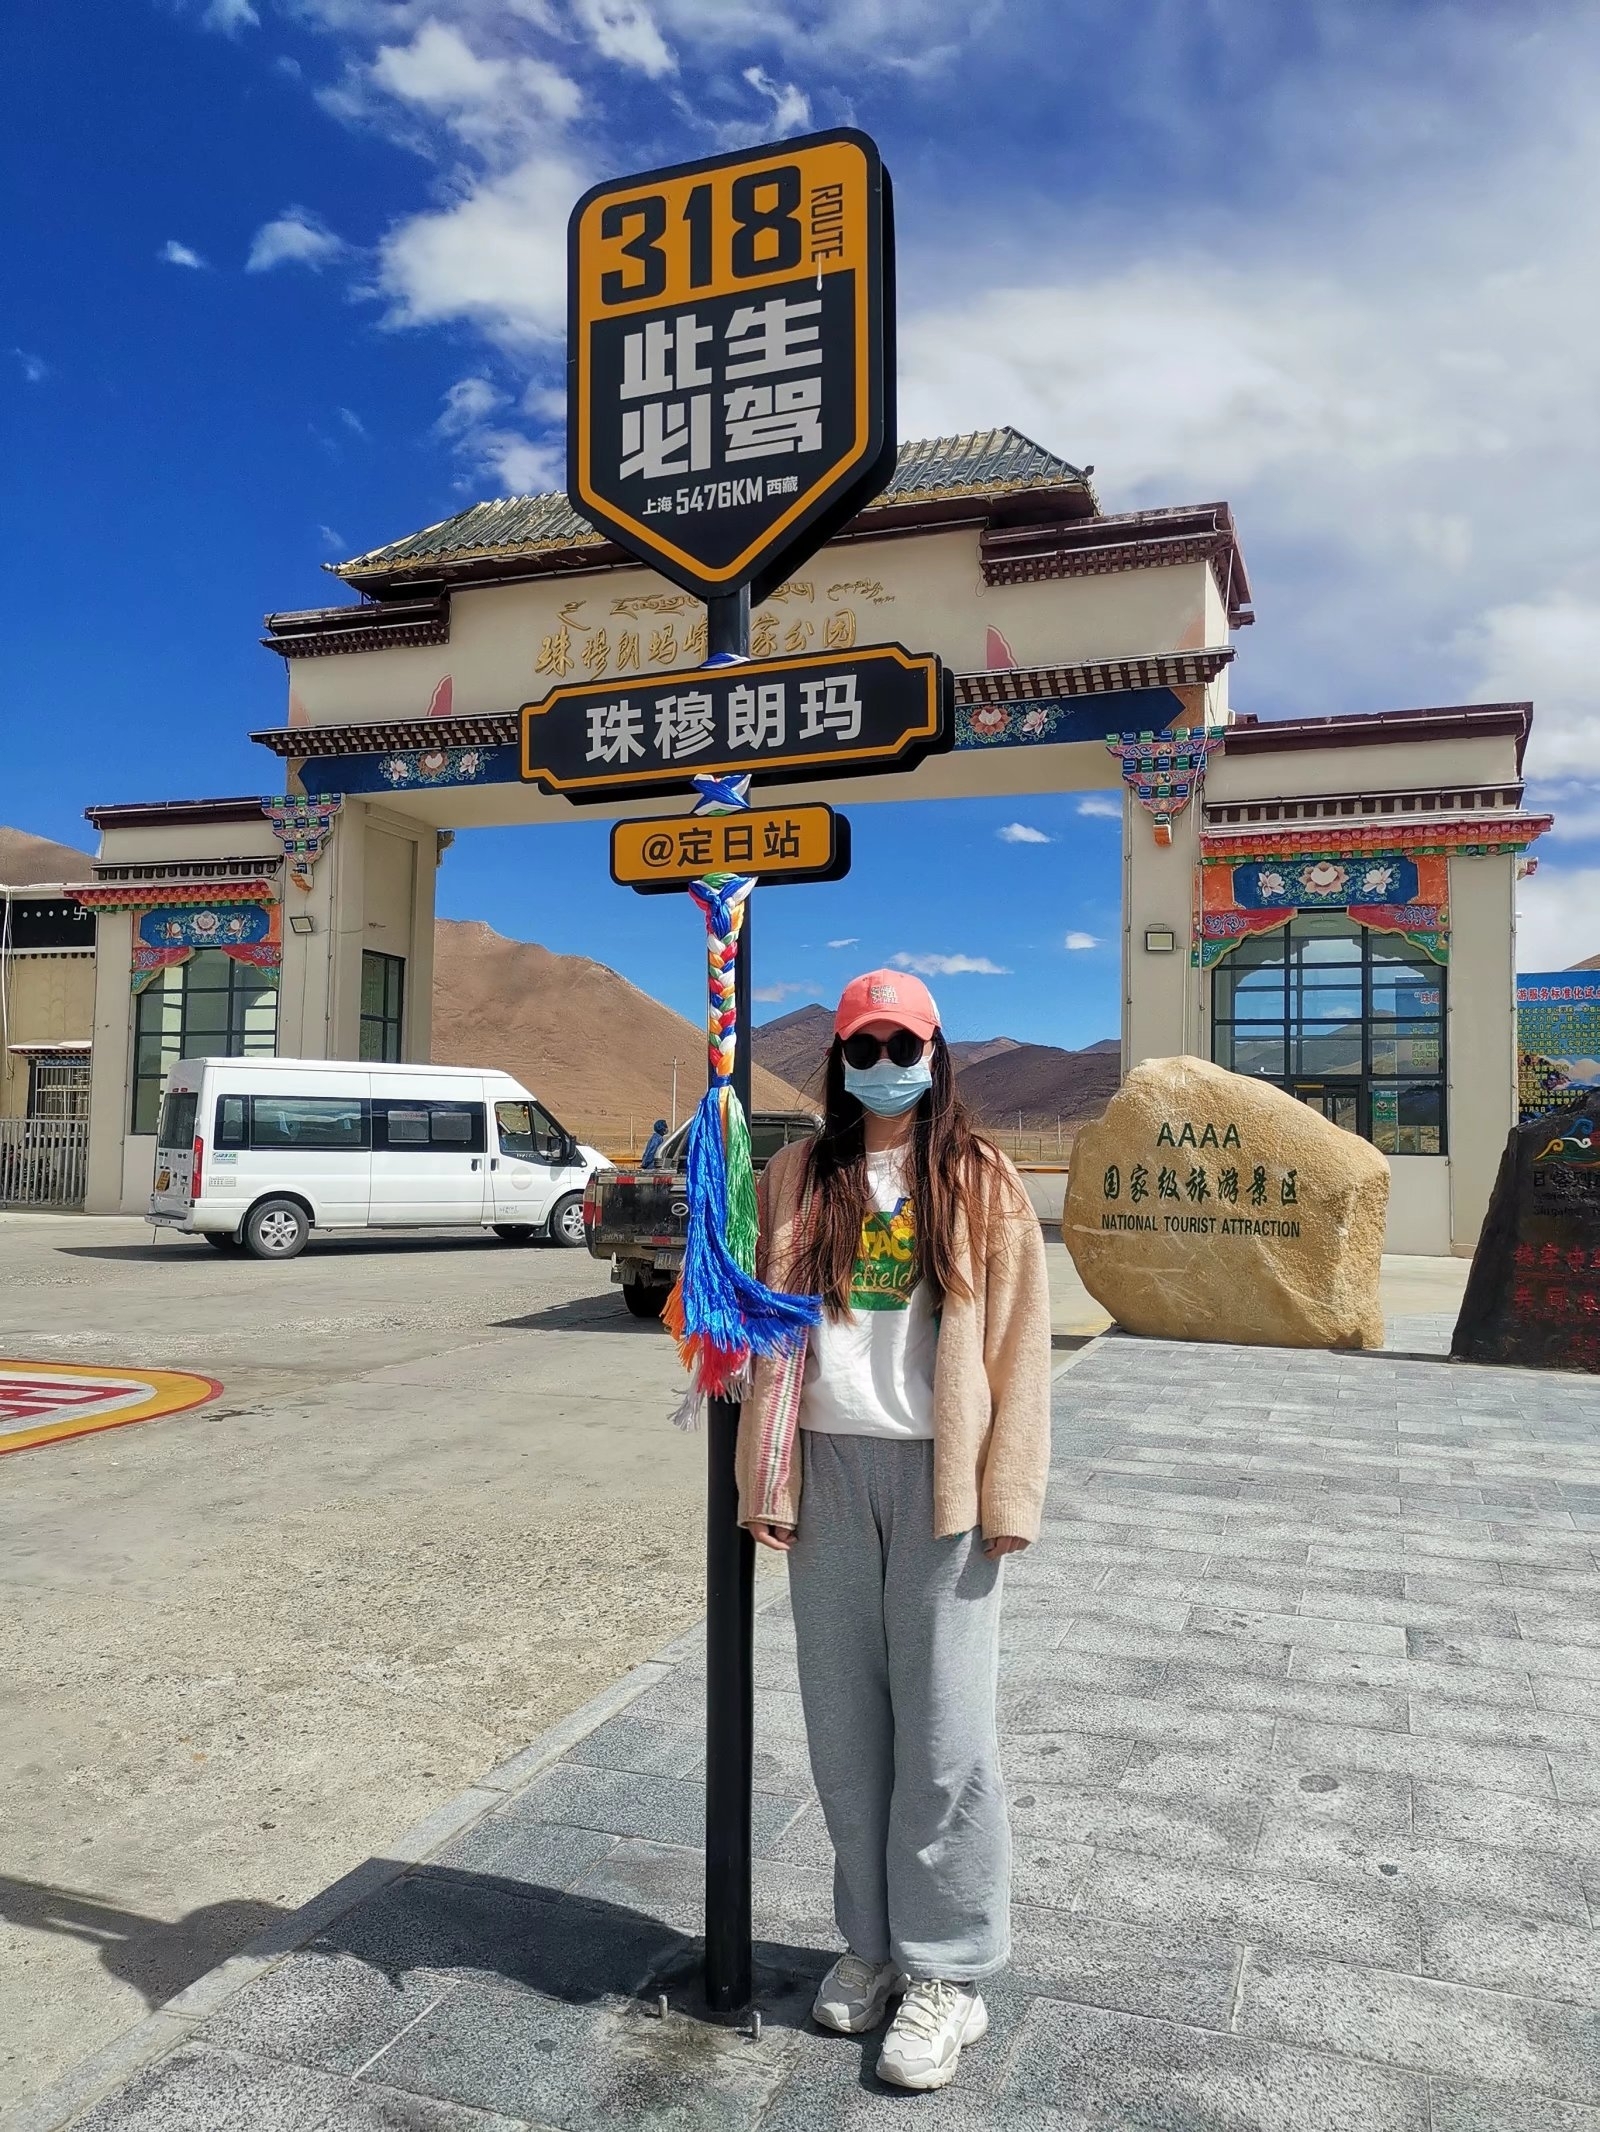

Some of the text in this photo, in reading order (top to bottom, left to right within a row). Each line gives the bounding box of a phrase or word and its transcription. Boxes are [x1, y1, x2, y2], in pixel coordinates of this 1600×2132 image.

[601, 165, 802, 306] 318
[810, 183, 843, 263] ROUTE
[619, 298, 823, 401] 此生
[619, 377, 823, 481] 必驾
[642, 475, 799, 516] 上海 5476KM 西藏
[585, 674, 863, 764] 珠穆朗玛
[641, 819, 801, 868] @定日站
[1156, 1122, 1242, 1149] AAAA
[1103, 1164, 1299, 1206] 国家级旅游景区
[1101, 1213, 1301, 1238] NATIONAL TOURIST ATTRACTION
